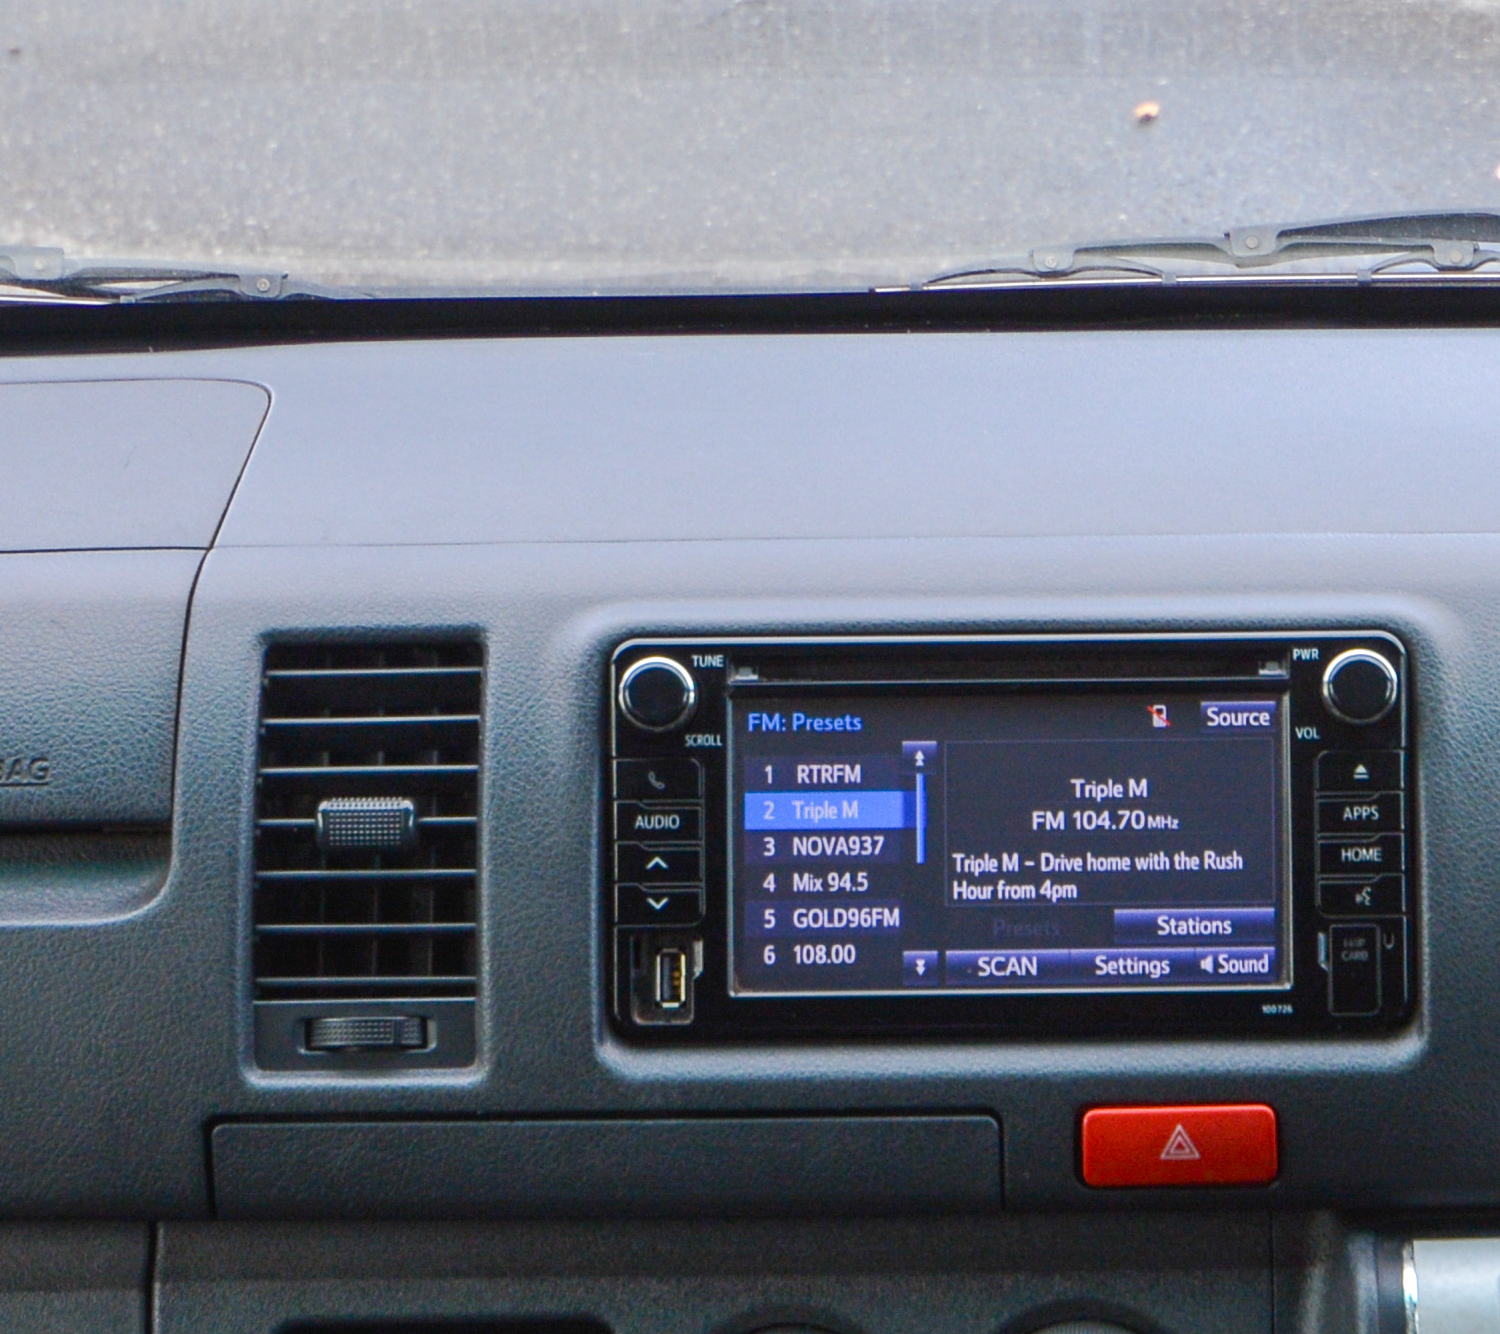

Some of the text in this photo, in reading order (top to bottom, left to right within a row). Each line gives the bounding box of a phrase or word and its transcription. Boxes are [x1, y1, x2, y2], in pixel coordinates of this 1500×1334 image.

[691, 655, 724, 668] TUNE
[1293, 649, 1319, 661] PWR
[748, 713, 862, 732] FM: Presets
[1207, 707, 1270, 727] Source
[685, 734, 723, 747] SCROLL
[1295, 727, 1320, 739] VOL
[764, 765, 861, 784] 1 RTRFM
[1070, 778, 1148, 802] Triple M
[634, 815, 680, 830] AUDIO
[763, 801, 859, 825] 2 Triple M
[1032, 811, 1065, 831] FM
[1343, 806, 1379, 820] APPS
[763, 835, 885, 856] 3 NOVA937
[1341, 848, 1383, 862] HOME
[952, 853, 998, 876] Triple
[1002, 853, 1019, 872] M
[1041, 852, 1083, 872] Drive
[1087, 852, 1131, 871] home
[1135, 851, 1171, 871] with
[1174, 851, 1200, 870] the
[1204, 851, 1243, 870] Rush
[763, 872, 869, 892] 4 Mix 94.5
[952, 880, 1077, 903] Hour from 4pm
[764, 908, 900, 928] 5 GOLD96FM
[1157, 915, 1232, 936] Stations
[764, 944, 856, 964] 6 108.00
[1218, 954, 1269, 974] Sound
[977, 956, 1038, 977] SCAN
[1095, 955, 1170, 979] Settings
